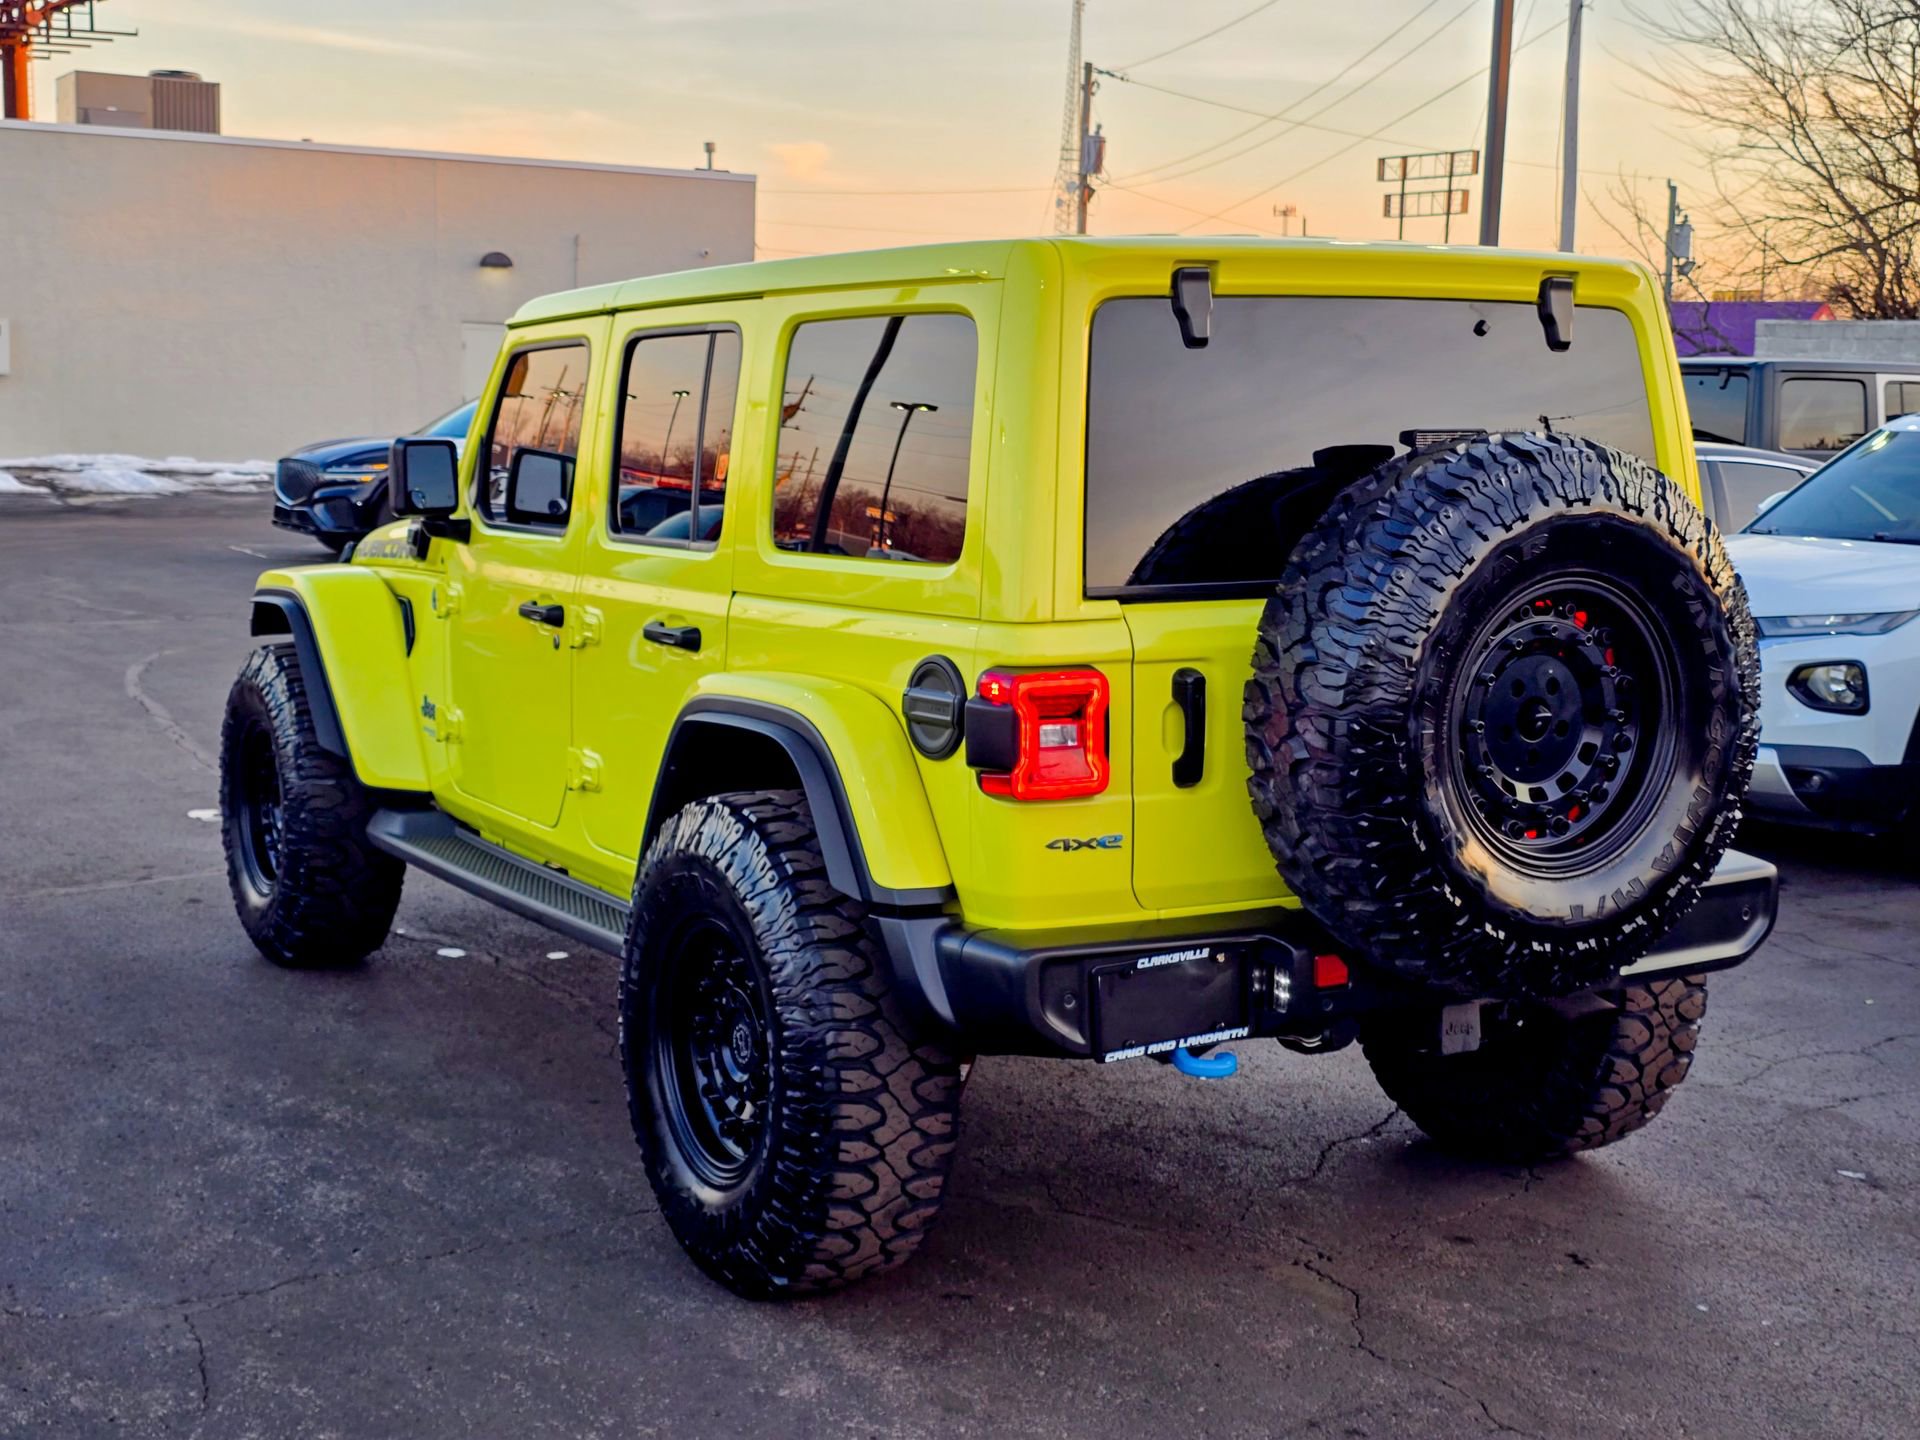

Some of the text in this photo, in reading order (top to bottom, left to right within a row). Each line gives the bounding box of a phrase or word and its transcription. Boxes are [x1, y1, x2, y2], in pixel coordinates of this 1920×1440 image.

[1651, 570, 1727, 872] PATAGONIA
[1136, 947, 1210, 969] CLARKSVILLE
[1147, 1040, 1177, 1054] AND
[1178, 1027, 1249, 1049] LANDRETH
